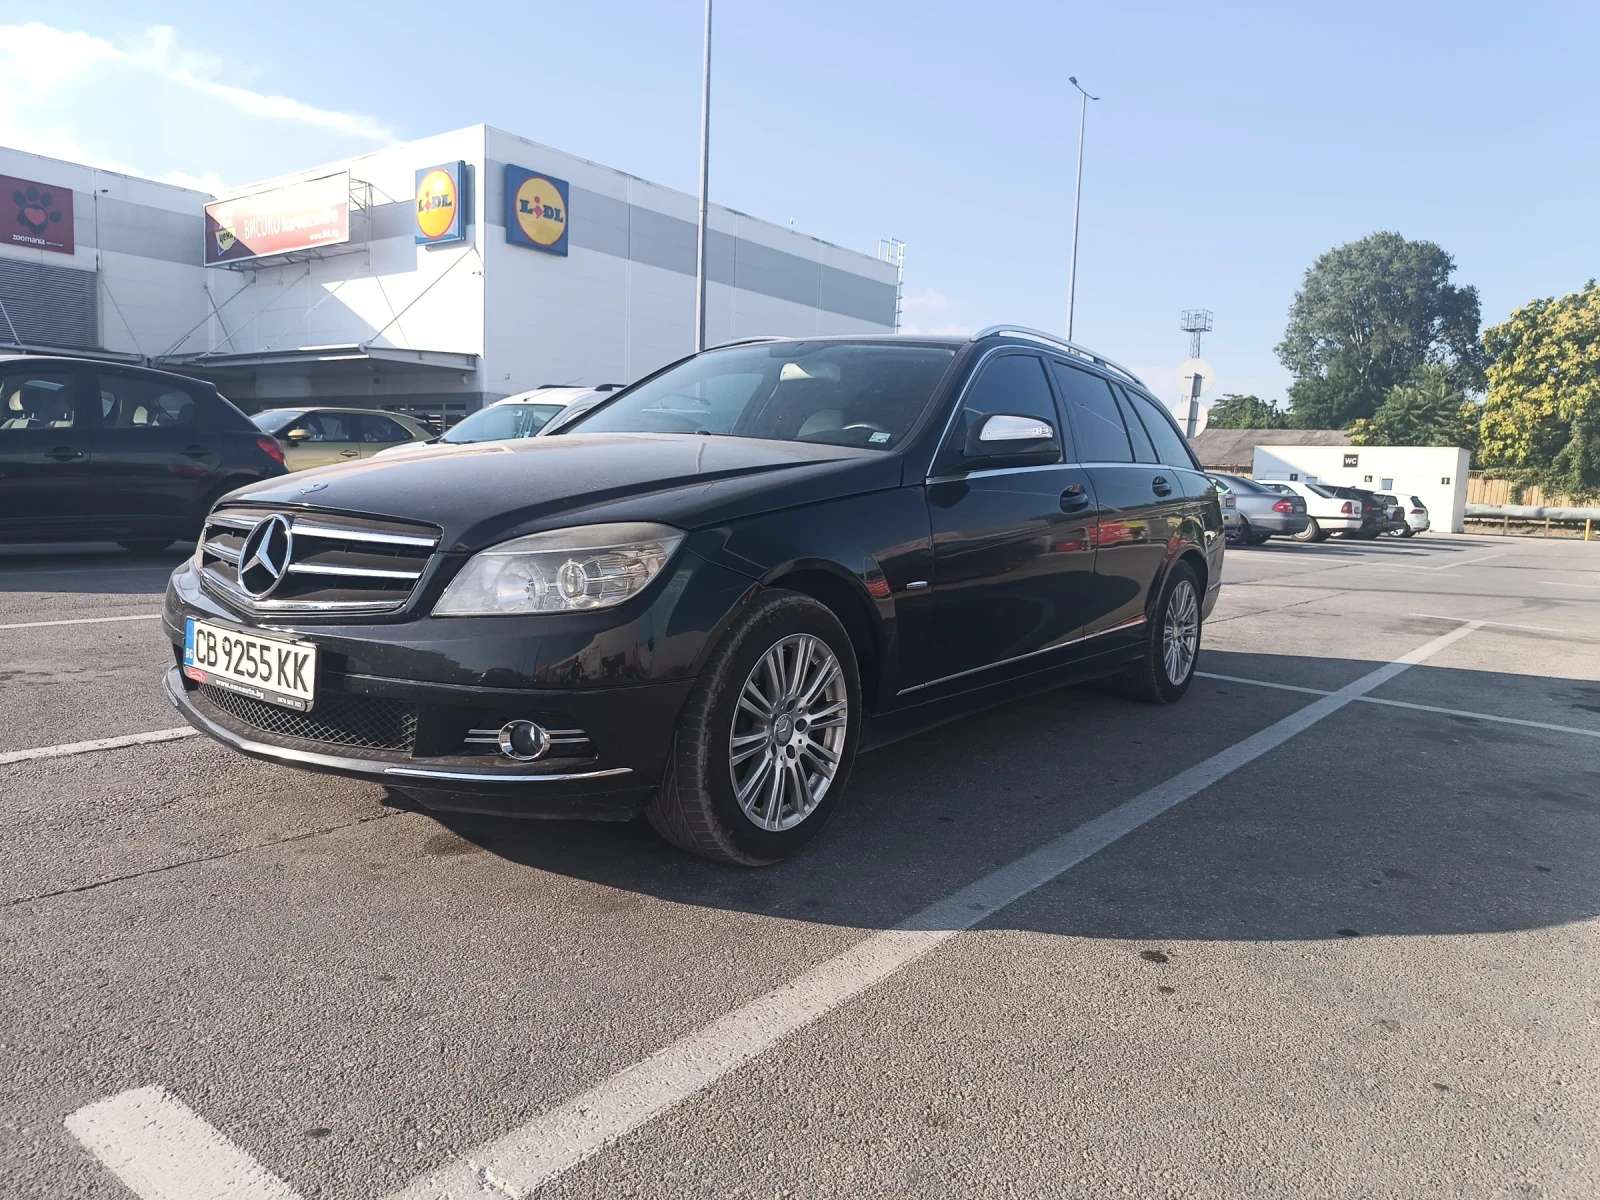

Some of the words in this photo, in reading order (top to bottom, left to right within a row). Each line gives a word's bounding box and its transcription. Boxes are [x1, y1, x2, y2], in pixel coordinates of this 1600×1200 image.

[244, 215, 280, 240] ВИСОКО
[12, 234, 45, 245] zoomania
[1344, 457, 1357, 465] WC
[186, 648, 194, 659] BG
[196, 628, 218, 667] CB
[222, 636, 272, 682] 9255
[277, 648, 310, 693] KK
[215, 679, 265, 699] www.emoauto.bg
